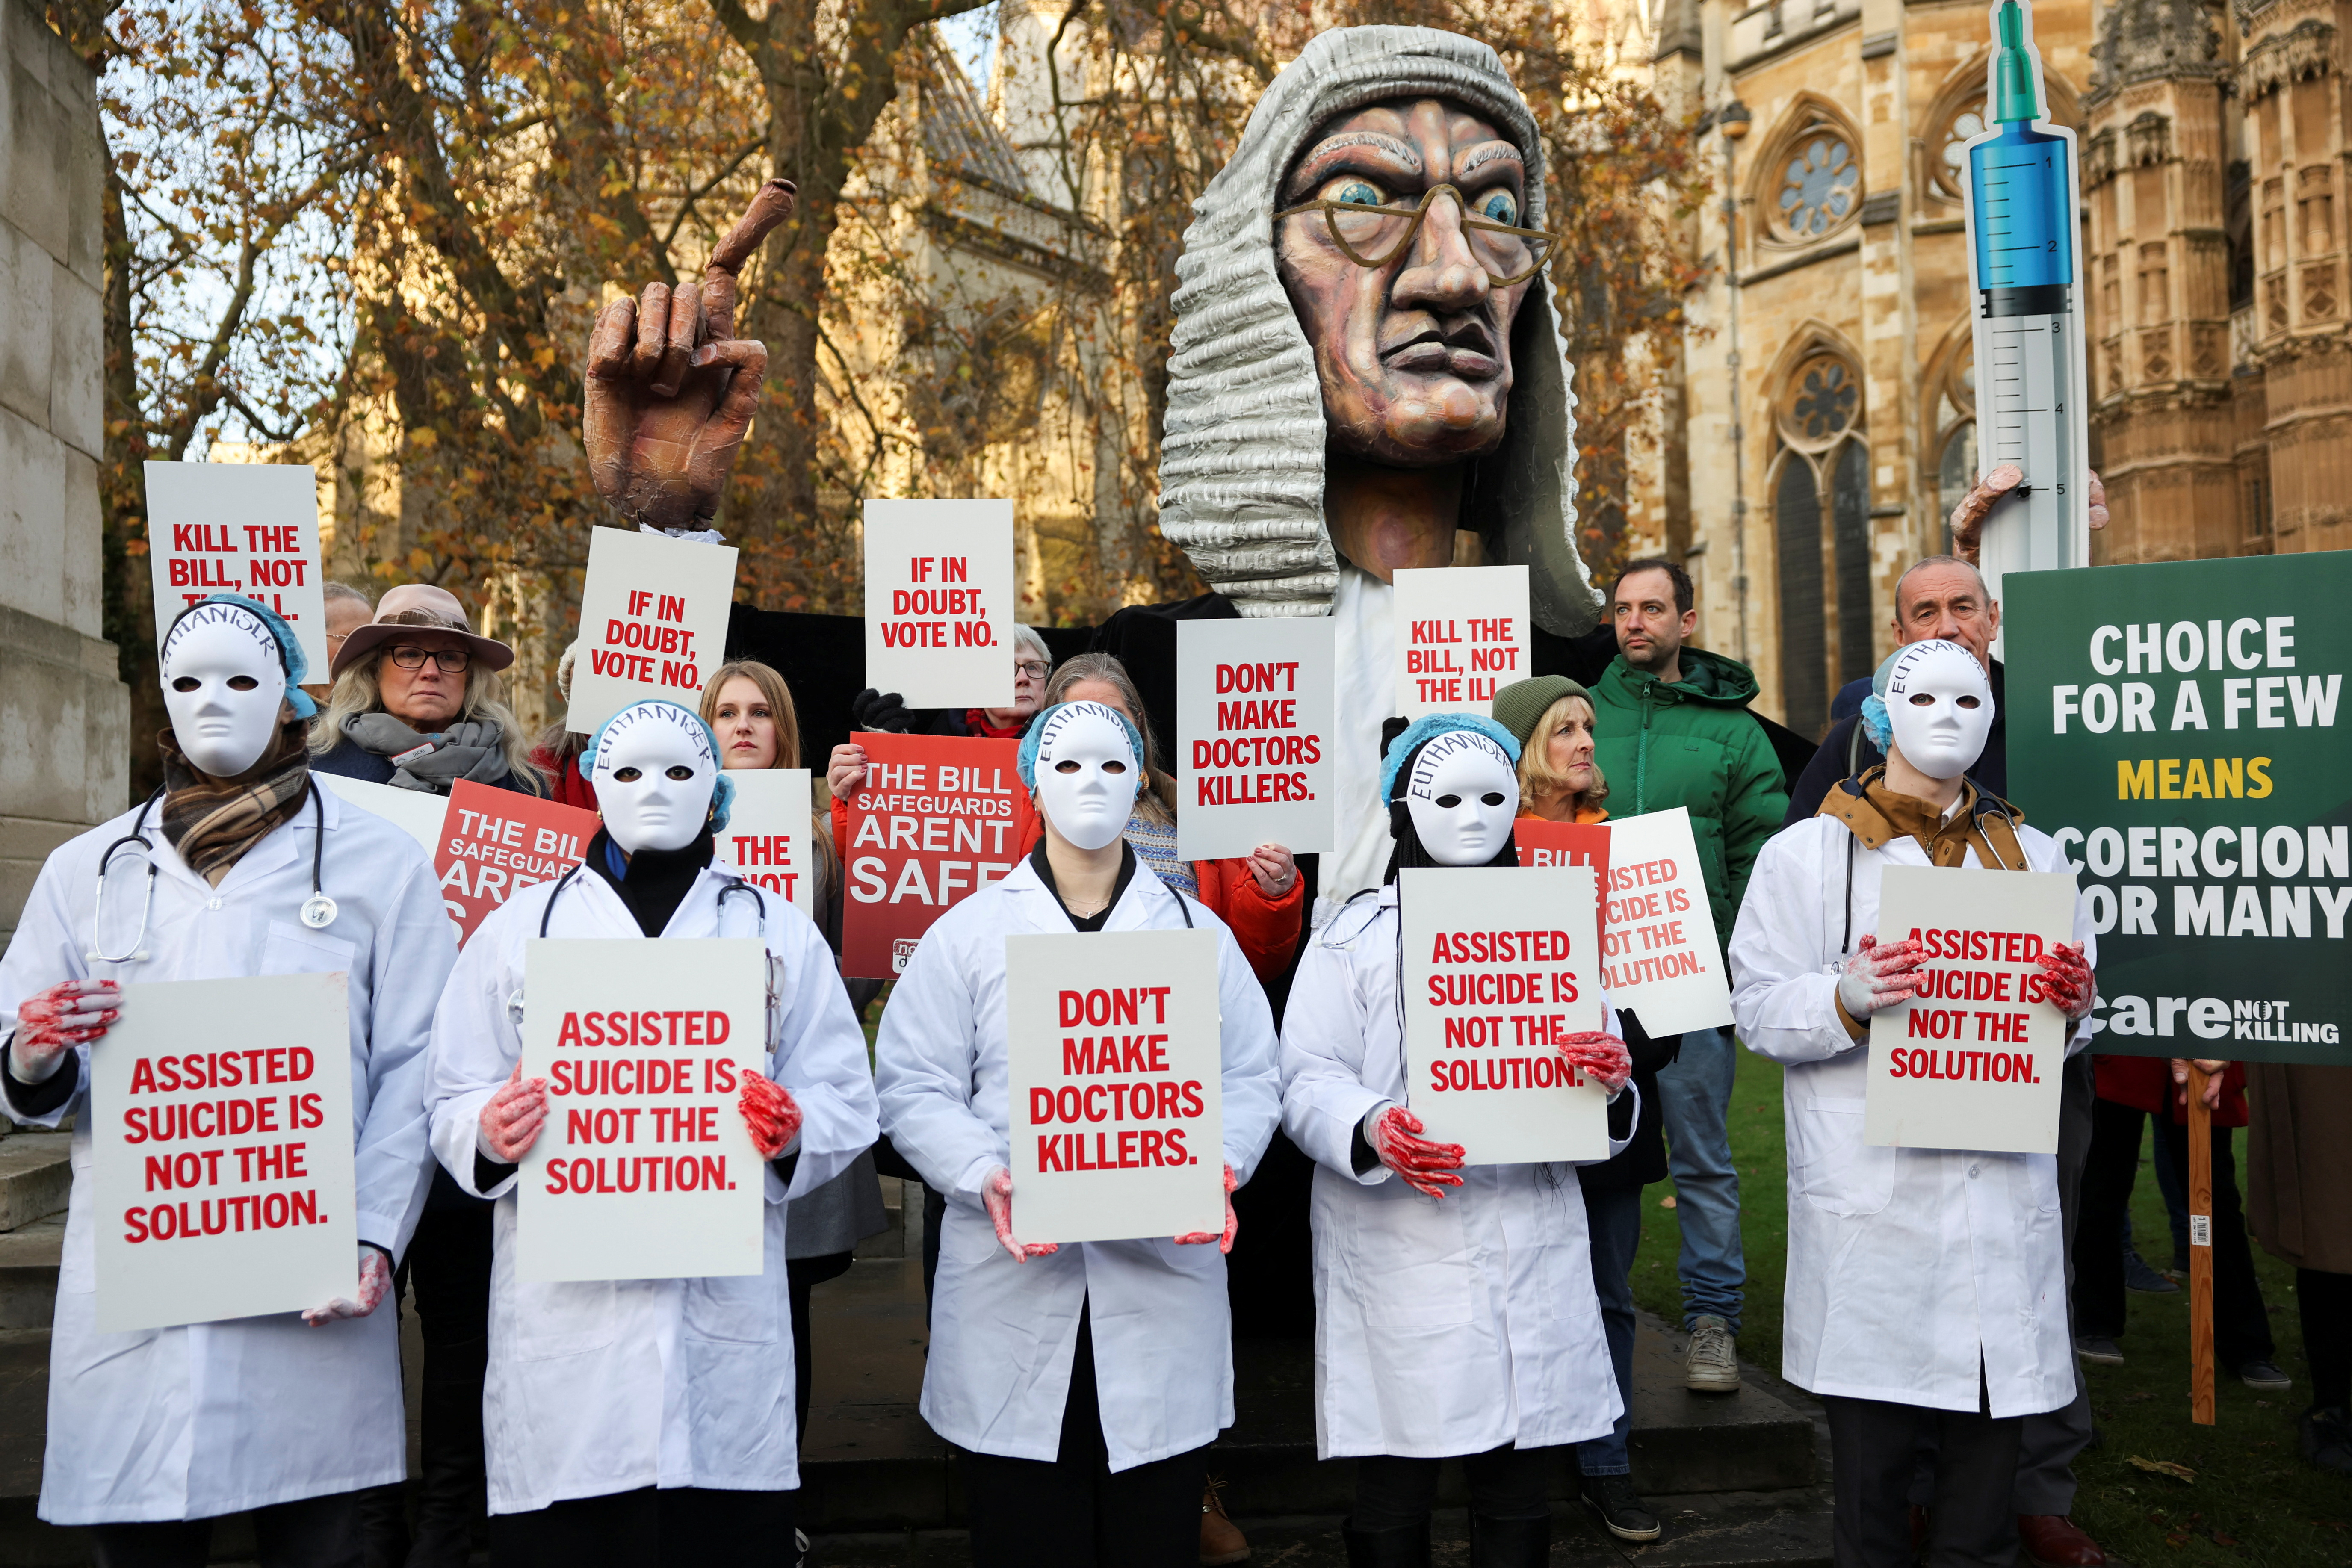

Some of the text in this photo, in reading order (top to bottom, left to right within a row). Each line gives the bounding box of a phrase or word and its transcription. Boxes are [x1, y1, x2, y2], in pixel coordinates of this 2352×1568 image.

[2046, 157, 2051, 168] 1
[2048, 241, 2057, 252] 2
[2052, 322, 2060, 333] 3
[2055, 403, 2063, 413] 4
[2057, 484, 2065, 495] 5
[174, 524, 299, 552] KILL THE
[170, 559, 307, 591] BILL, NOT
[912, 557, 966, 582] IF IN
[629, 591, 685, 622] IF IN
[894, 589, 985, 619] DOUBT,
[606, 619, 696, 662] DOUBT,
[881, 621, 997, 647] VOTE NO.
[1412, 618, 1513, 644] KILL THE
[2090, 616, 2295, 675] CHOICE
[592, 649, 702, 690] VOTE NO.
[1217, 662, 1298, 693] DON'T
[1408, 648, 1519, 676] BILL, NOT
[1416, 679, 1462, 702] THE
[2053, 675, 2342, 734] FOR A FEW
[1219, 700, 1296, 730] MAKE
[412, 749, 425, 757] JACKI
[597, 705, 710, 769] EUTHANISER
[1194, 735, 1320, 769] DOCTORS
[863, 763, 1011, 794] THE BILL
[1412, 733, 1510, 800] EUTHANISER
[2118, 757, 2272, 799] MEANS
[858, 794, 1011, 816] SAFEGUARDS
[1199, 772, 1314, 806] KILLERS.
[458, 809, 585, 862] THE BIL
[733, 836, 790, 865] THE
[853, 815, 1013, 853] ARENT
[449, 838, 573, 879] SAFEGUAR
[2053, 826, 2349, 877] COERCION
[1607, 859, 1677, 893] ISTED
[1605, 893, 1662, 925] CIDE
[1666, 889, 1690, 912] IS
[2081, 884, 2352, 938] OR MANY
[1433, 931, 1570, 963] ASSISTED
[1604, 921, 1686, 957] OT THE
[1908, 927, 2043, 963] ASSISTED
[1602, 950, 1706, 990] OLUTION.
[1429, 972, 1578, 1006] SUICIDE IS
[2019, 973, 2045, 1004] IS
[1060, 987, 1170, 1027] DON'T
[2234, 1000, 2289, 1020] NOT
[558, 1011, 730, 1046] ASSISTED
[1445, 1014, 1565, 1048] NOT THE
[1909, 1009, 2029, 1042] NOT THE
[2234, 1020, 2339, 1044] KILLING
[130, 1047, 313, 1094] ASSISTED
[1064, 1035, 1169, 1075] MAKE
[1891, 1048, 2039, 1083] SOLUTION.
[551, 1059, 736, 1096] SUICIDE IS
[1430, 1057, 1583, 1092] SOLUTION.
[124, 1093, 323, 1143] SUICIDE IS
[1031, 1081, 1203, 1124] DOCTORS
[568, 1107, 718, 1144] NOT THE
[146, 1143, 307, 1191] NOT THE
[1039, 1129, 1197, 1172] KILLERS.
[547, 1156, 735, 1194] SOLUTION.
[125, 1190, 327, 1243] SOLUTION.
